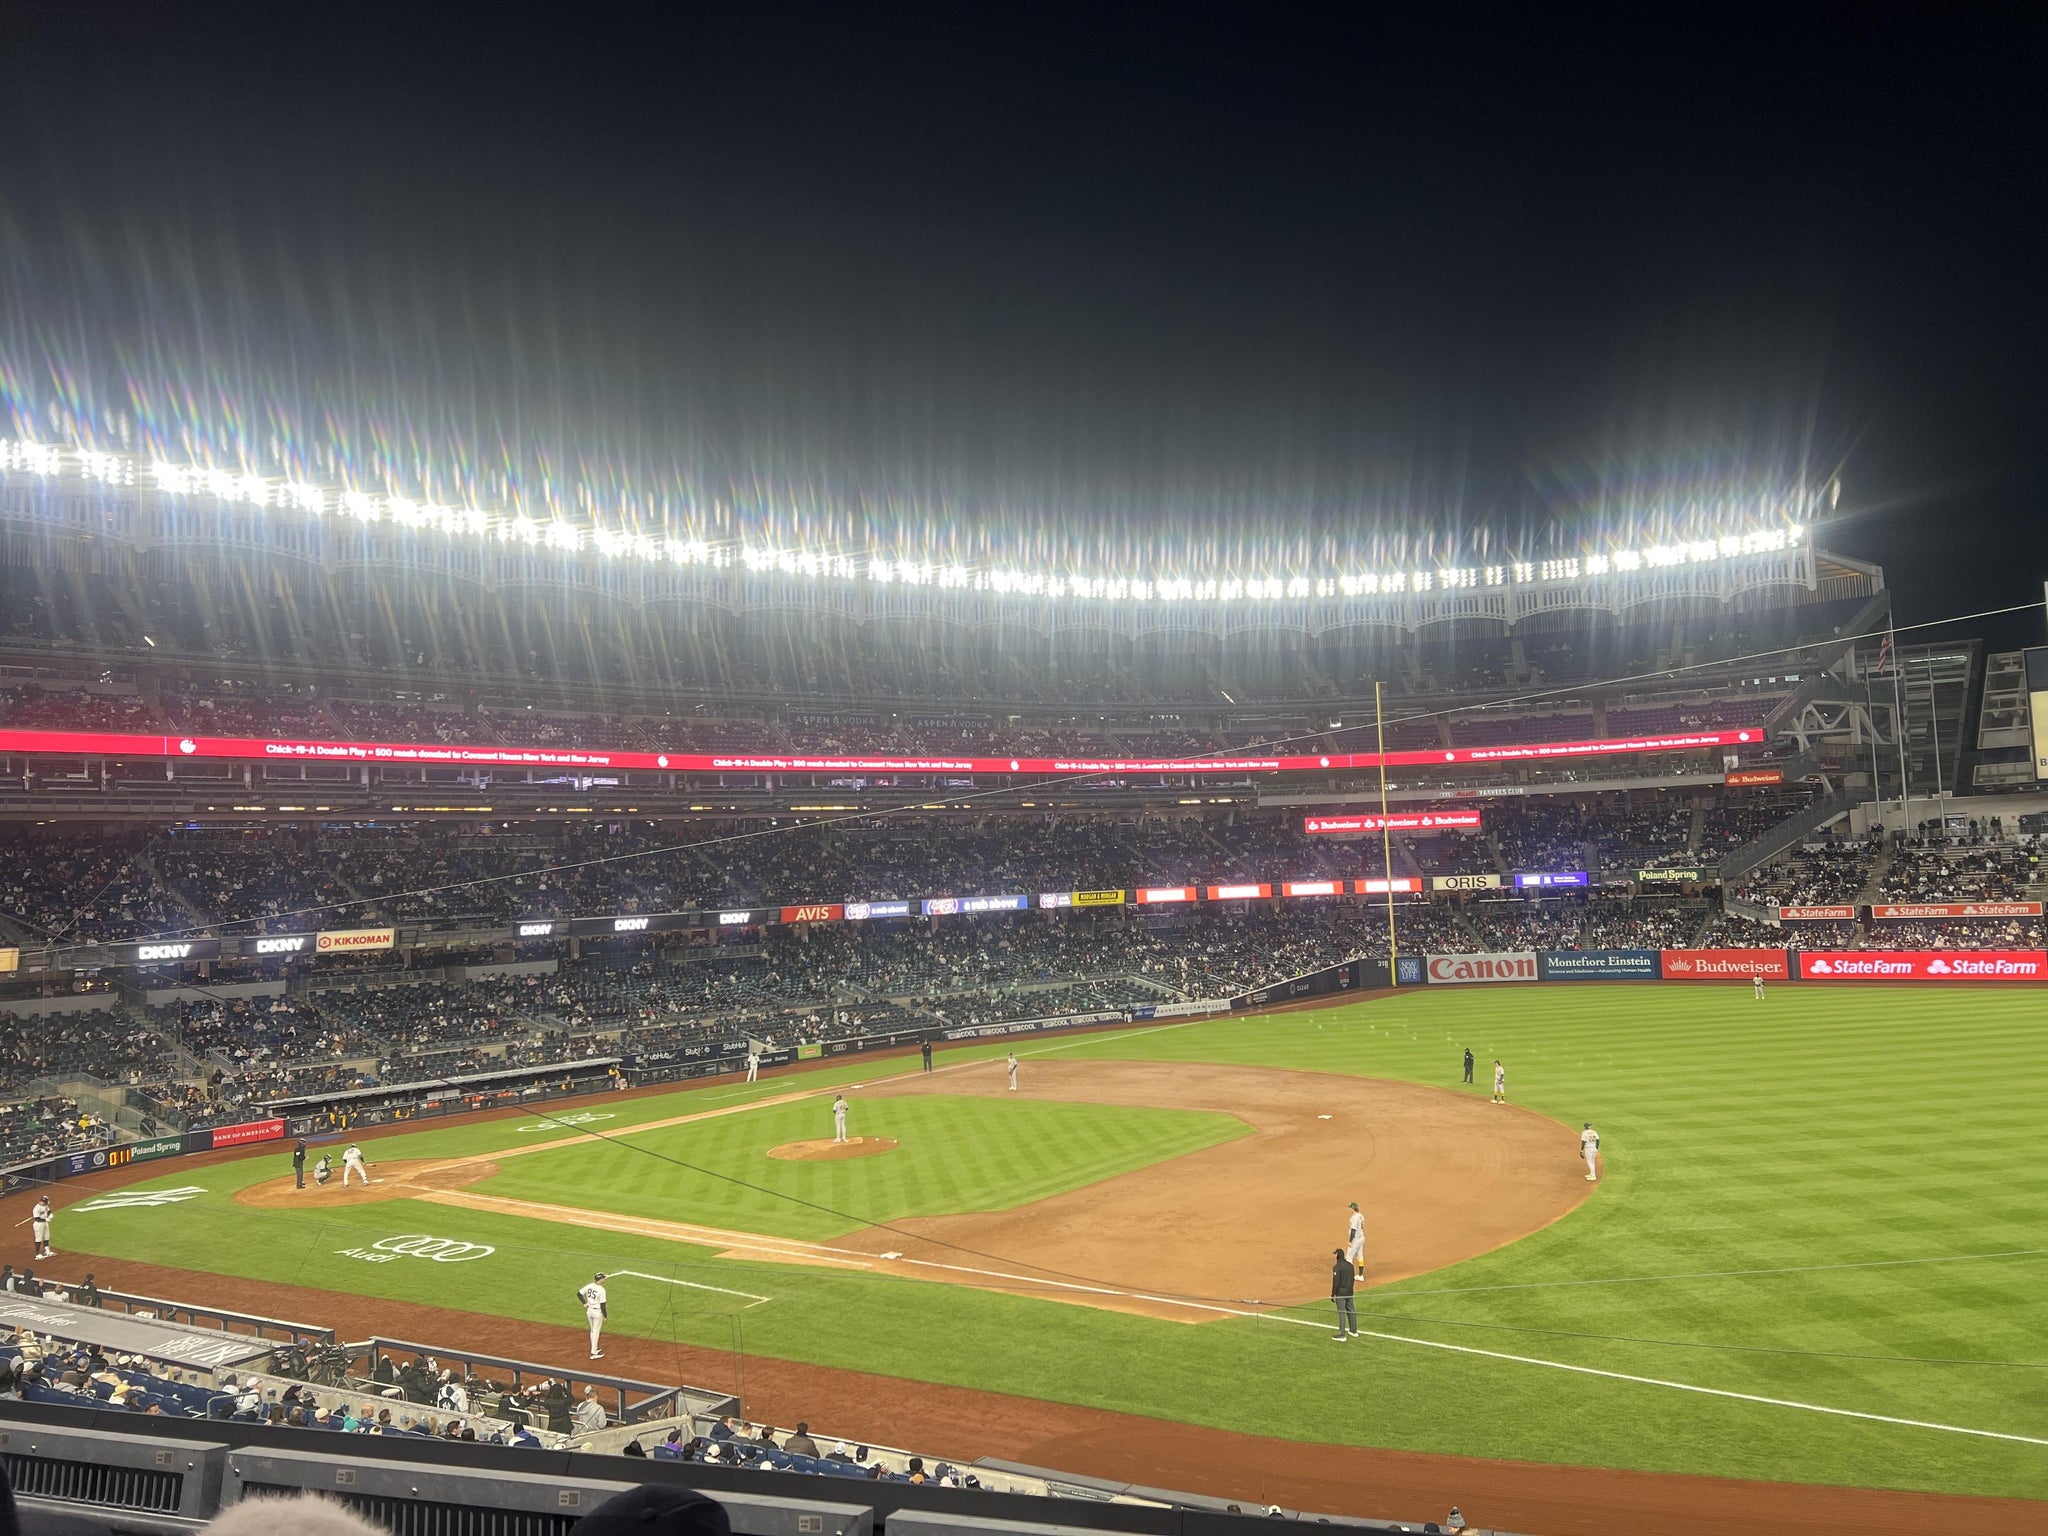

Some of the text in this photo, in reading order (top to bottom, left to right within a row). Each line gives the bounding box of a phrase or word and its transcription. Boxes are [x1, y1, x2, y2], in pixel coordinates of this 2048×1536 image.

[796, 716, 875, 724] ASPEN VODKA
[266, 744, 316, 754] Chick-fil-A
[317, 746, 348, 756] Double
[349, 746, 367, 758] Play
[375, 748, 392, 757] 500
[394, 749, 417, 758] meals
[418, 750, 451, 759] donated
[462, 751, 498, 760] Covenant
[500, 752, 522, 760] House
[524, 752, 540, 761] New
[540, 753, 556, 762] York
[557, 754, 570, 762] and
[572, 754, 587, 762] New
[588, 755, 610, 766] Jersey
[1742, 775, 1780, 783] Budweiser
[1479, 788, 1507, 796] YANKEES
[1321, 820, 1362, 830] Budweiser
[1435, 816, 1478, 825] Budweiser
[1639, 870, 1698, 881] Poland Spring
[1446, 876, 1487, 888] ORIS
[720, 913, 750, 924] DKNY
[796, 908, 830, 920] AVIS
[520, 924, 552, 936] DKNY
[614, 918, 648, 931] DKNY
[257, 938, 304, 954] DKNY
[334, 934, 390, 946] KIKKOMAN
[138, 944, 191, 960] DKNY
[1548, 956, 1651, 966] Montefiore Einstein
[1695, 959, 1782, 973] Budweiser
[1429, 958, 1535, 980] Canon
[723, 1042, 747, 1050] StubHub
[242, 1128, 270, 1137] AMERICA
[131, 1142, 180, 1157] Poland Spring
[333, 1248, 402, 1263] Audi
[588, 1288, 598, 1300] 95
